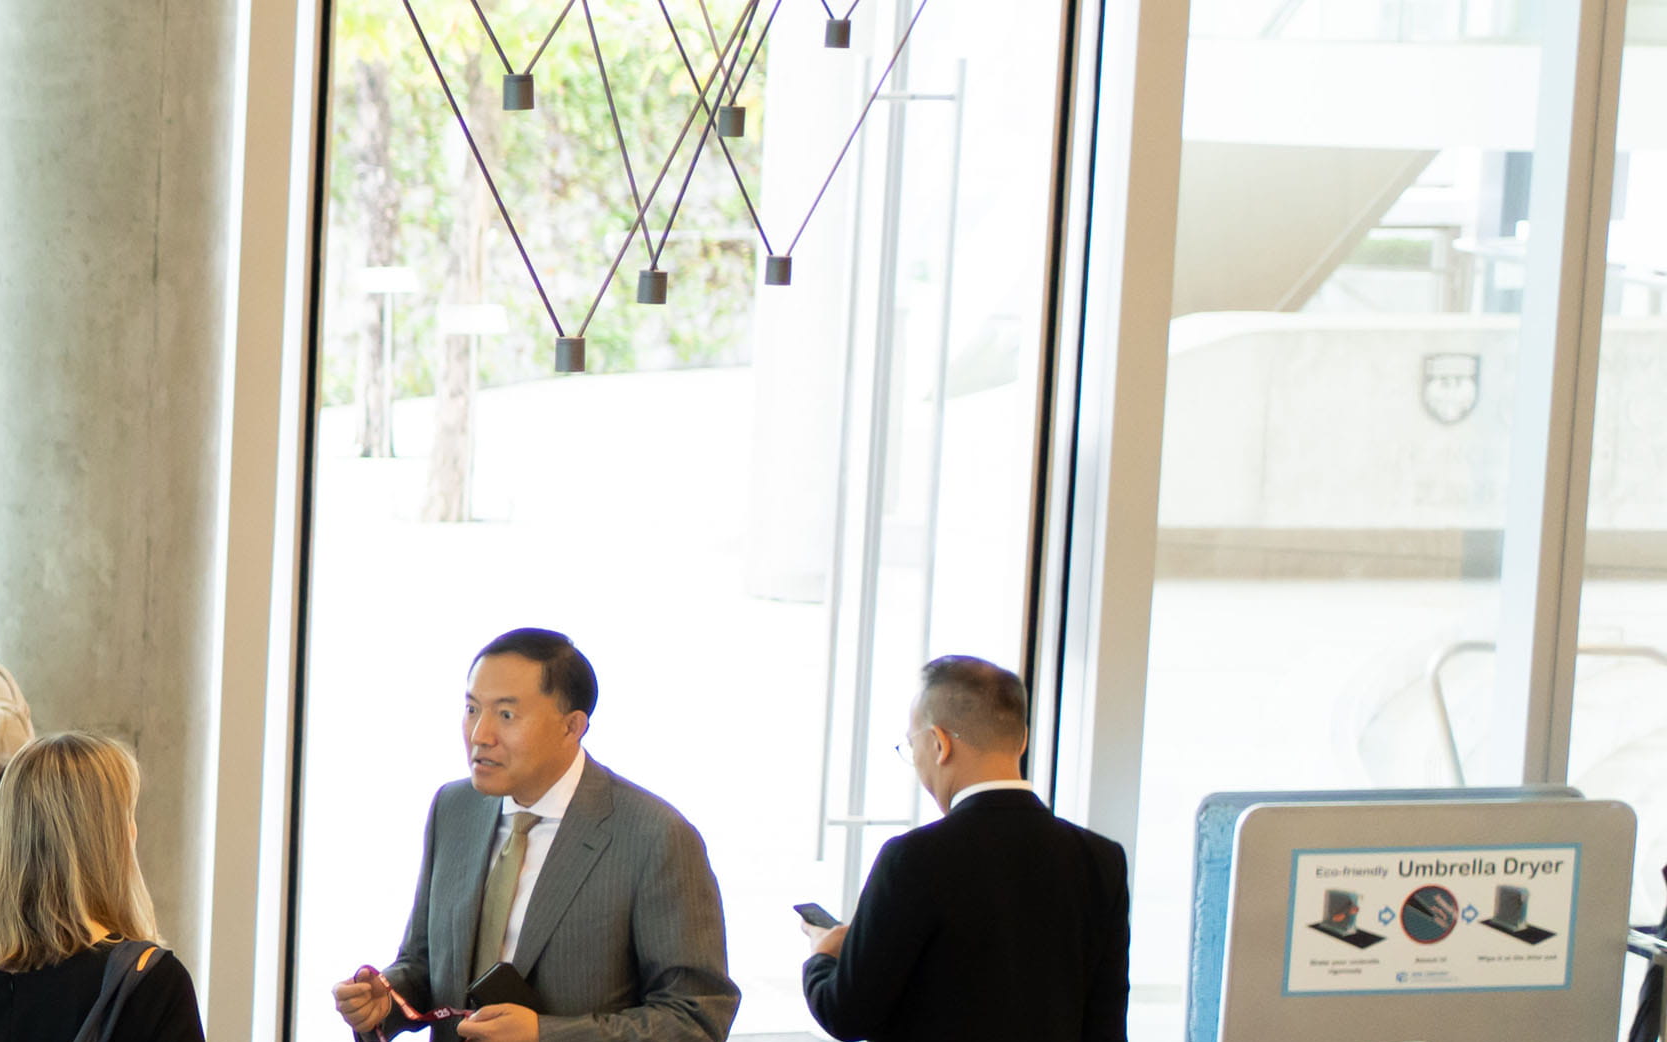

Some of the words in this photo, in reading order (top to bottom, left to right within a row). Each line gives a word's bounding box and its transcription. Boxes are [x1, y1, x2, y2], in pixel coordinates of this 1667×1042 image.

[1315, 865, 1388, 880] Eco-friendly
[1398, 859, 1496, 877] Umbrella
[1503, 857, 1564, 879] Dryer
